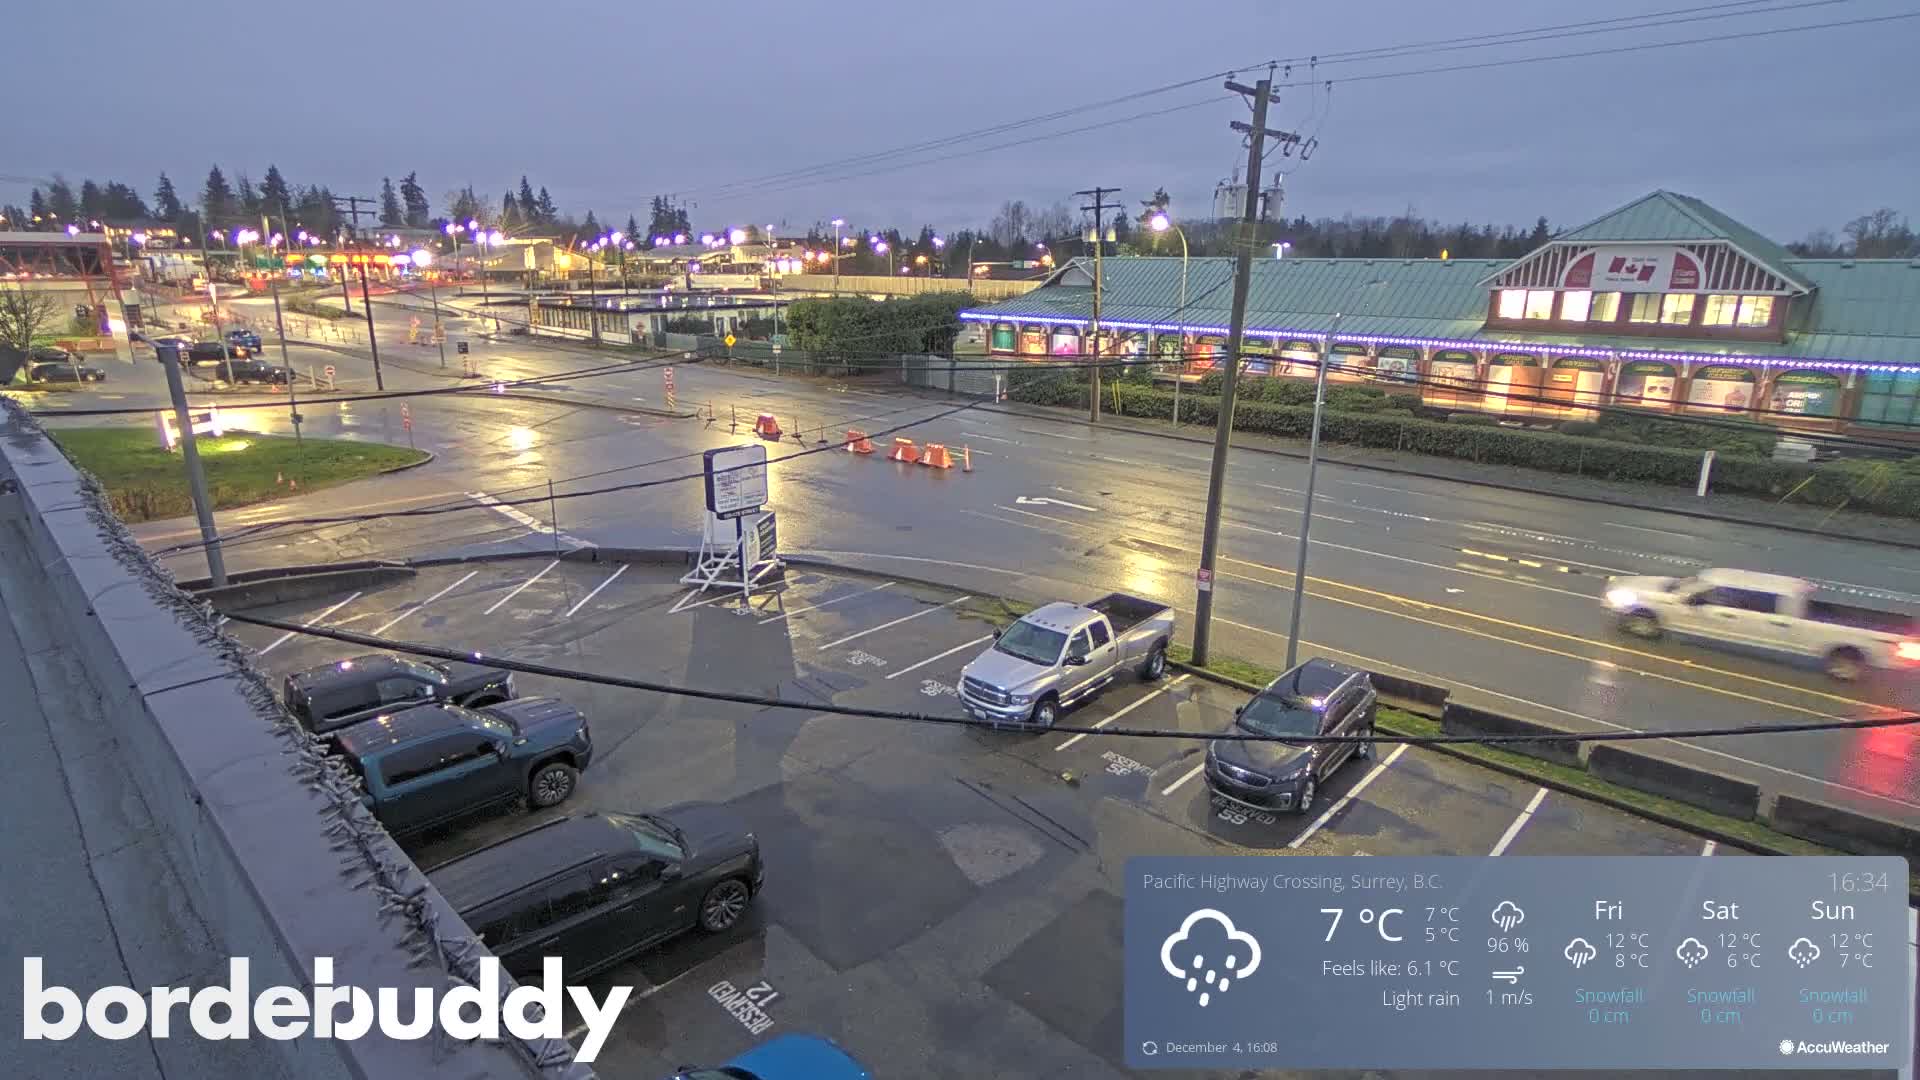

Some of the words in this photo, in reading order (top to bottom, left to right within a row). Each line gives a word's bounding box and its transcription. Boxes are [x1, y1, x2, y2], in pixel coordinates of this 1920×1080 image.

[1218, 809, 1248, 825] 59
[709, 980, 775, 1034] RESERVED
[746, 981, 779, 1007] 12
